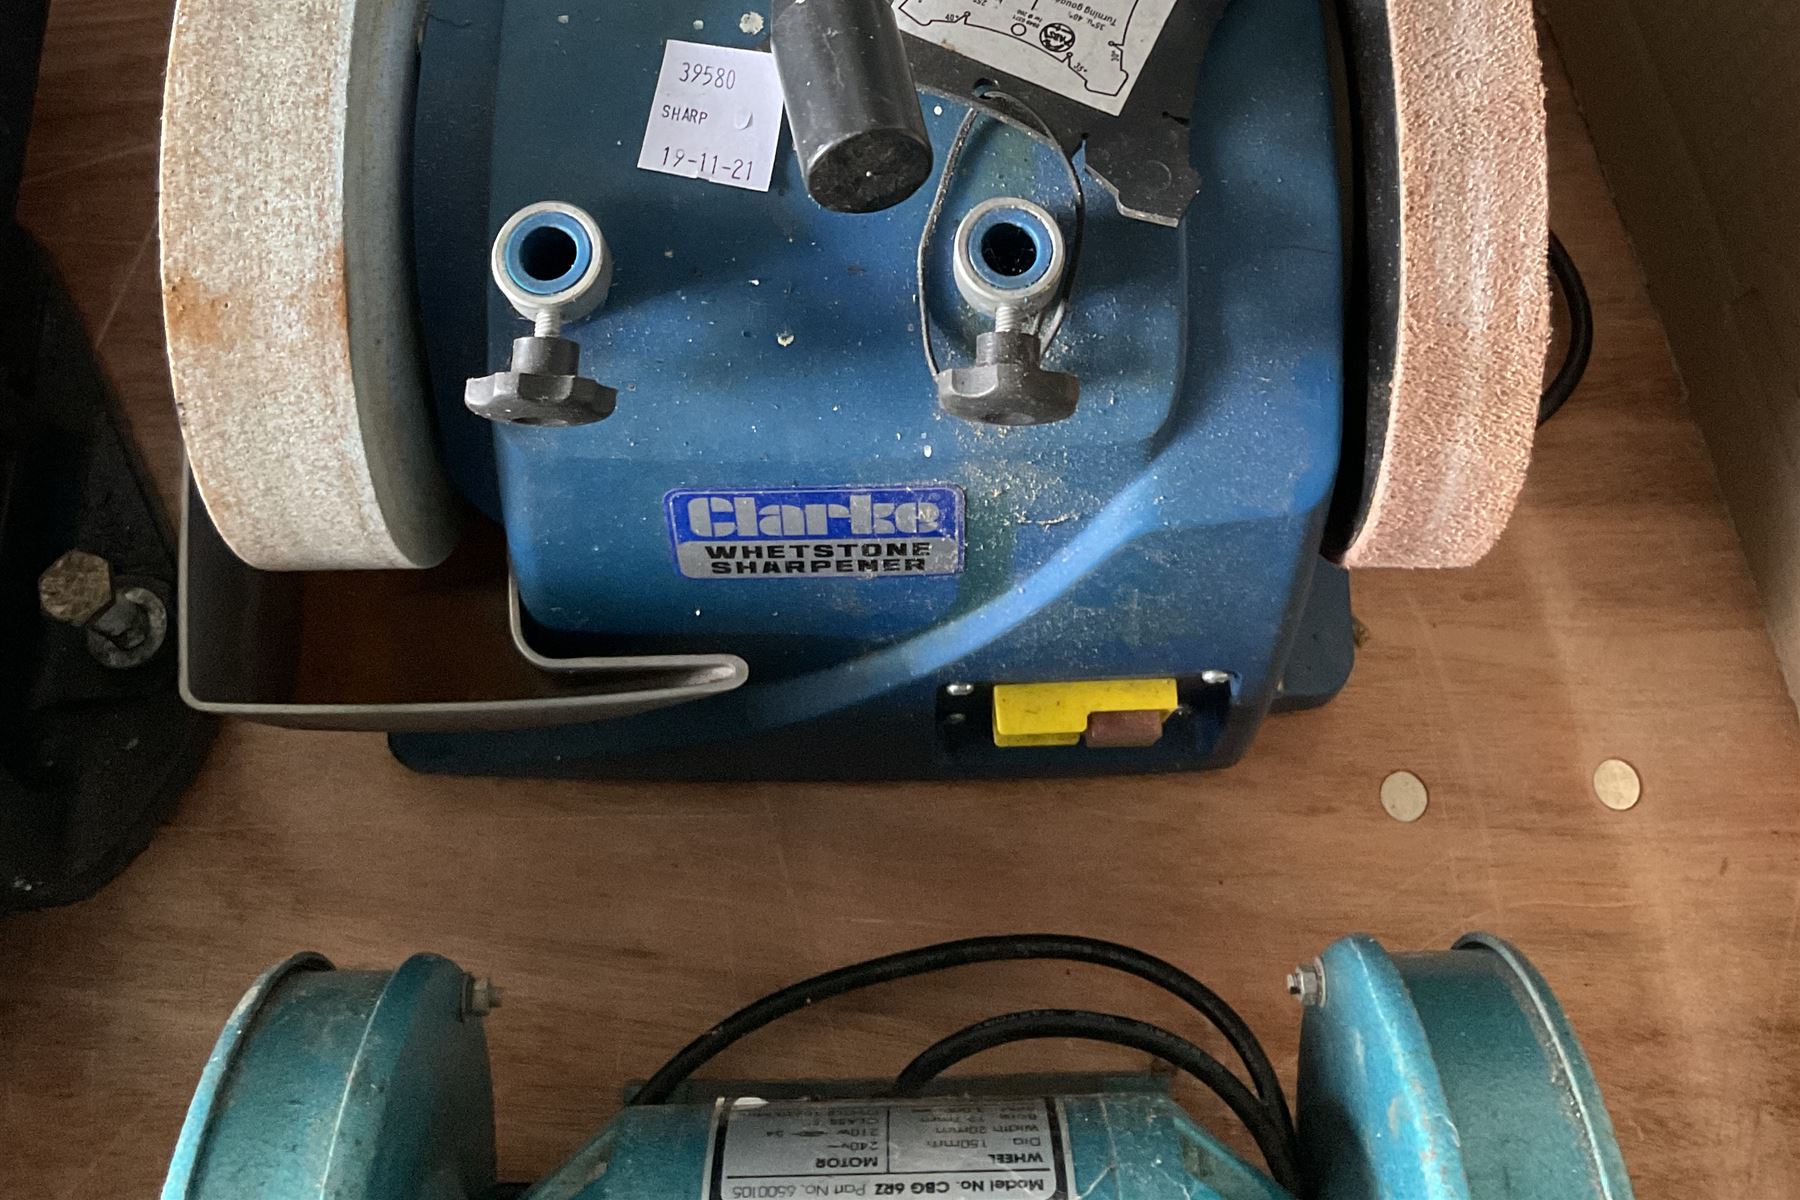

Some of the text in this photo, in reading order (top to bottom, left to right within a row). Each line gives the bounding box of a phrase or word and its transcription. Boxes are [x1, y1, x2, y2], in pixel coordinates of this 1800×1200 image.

[1084, 6, 1117, 26] Turning
[679, 62, 736, 90] 39580
[662, 104, 708, 125] SHARP
[662, 146, 753, 181] 19-11-21
[687, 494, 939, 538] Clarke
[704, 542, 931, 560] WHETSTONE
[711, 557, 926, 575] SHARPENER
[927, 1139, 987, 1149] 150mm
[816, 1157, 878, 1168] MOTOR
[988, 1152, 1044, 1164] WHEEL
[801, 1185, 829, 1196] No.
[835, 1183, 866, 1195] Part
[911, 1181, 950, 1194] CBG
[957, 1180, 984, 1192] No.
[991, 1179, 1044, 1192] Model
